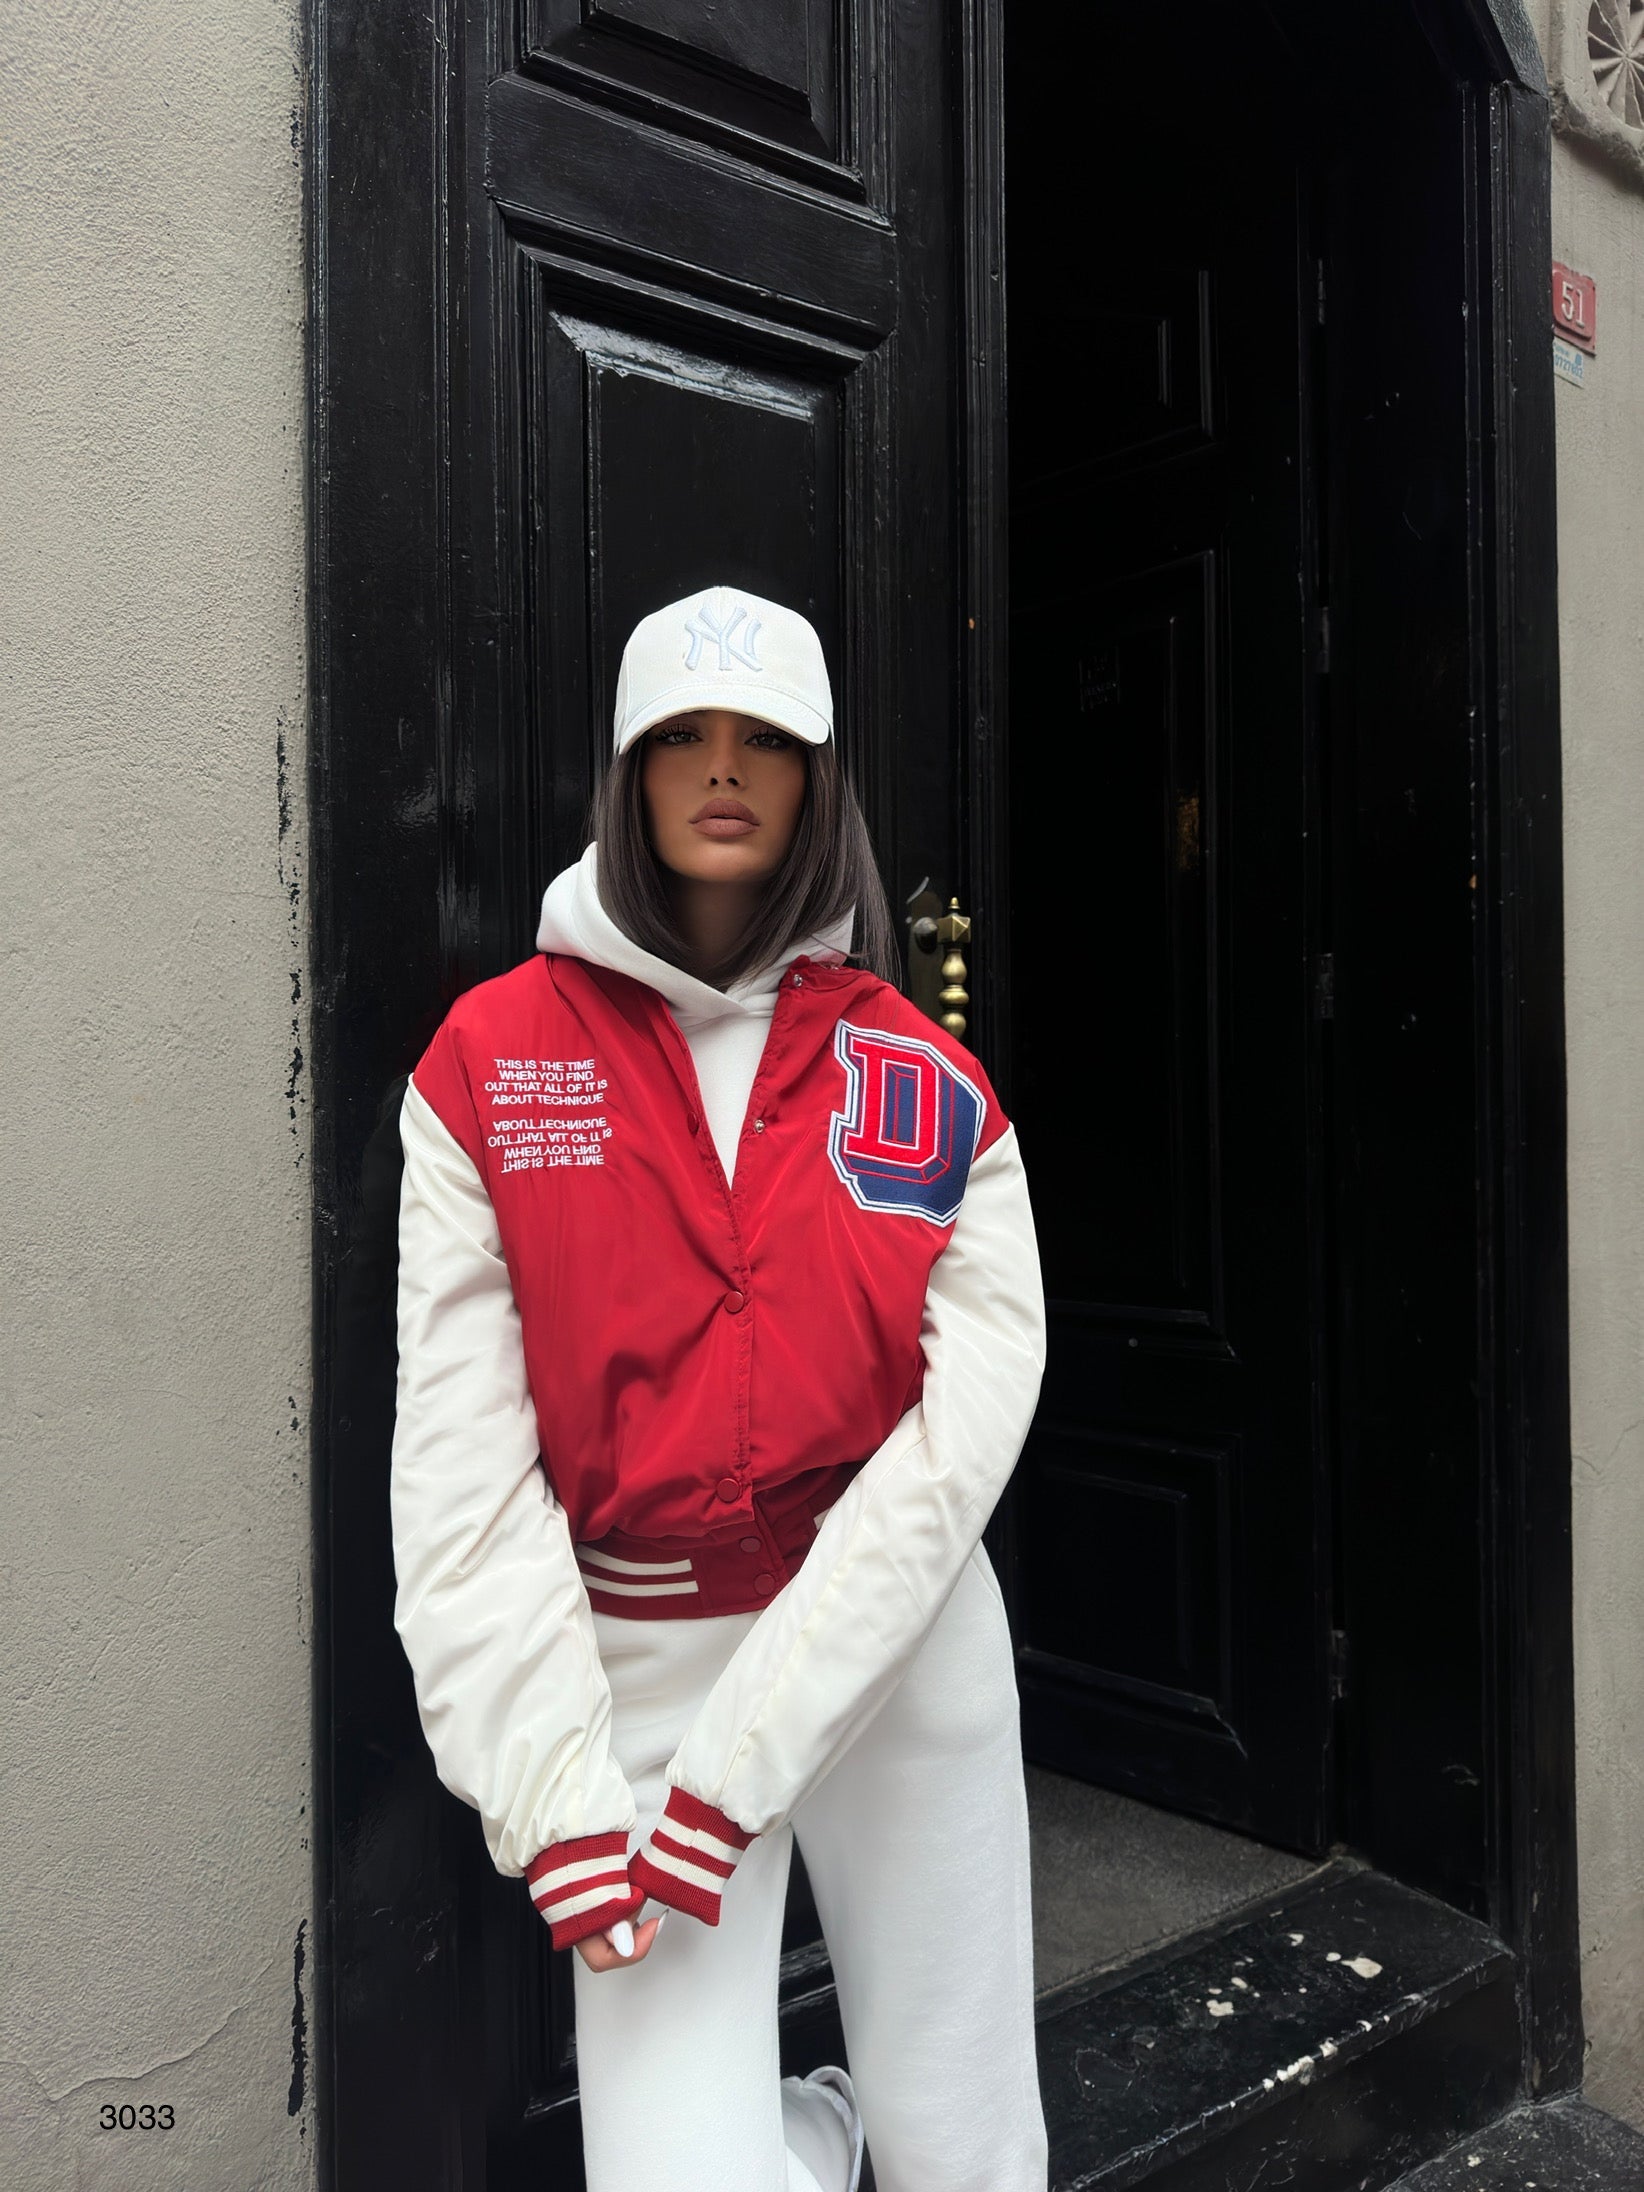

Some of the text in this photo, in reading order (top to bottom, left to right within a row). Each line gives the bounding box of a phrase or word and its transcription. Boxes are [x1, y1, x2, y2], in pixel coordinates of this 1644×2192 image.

[1561, 280, 1585, 329] 51
[494, 1059, 595, 1071] THIS IS THE TIME
[499, 1070, 593, 1082] WHEN YOU FIND
[485, 1079, 608, 1093] OUT THAT ALL OF IT IS
[492, 1093, 604, 1106] ABOUT TECHNIQUE
[842, 1034, 956, 1186] D
